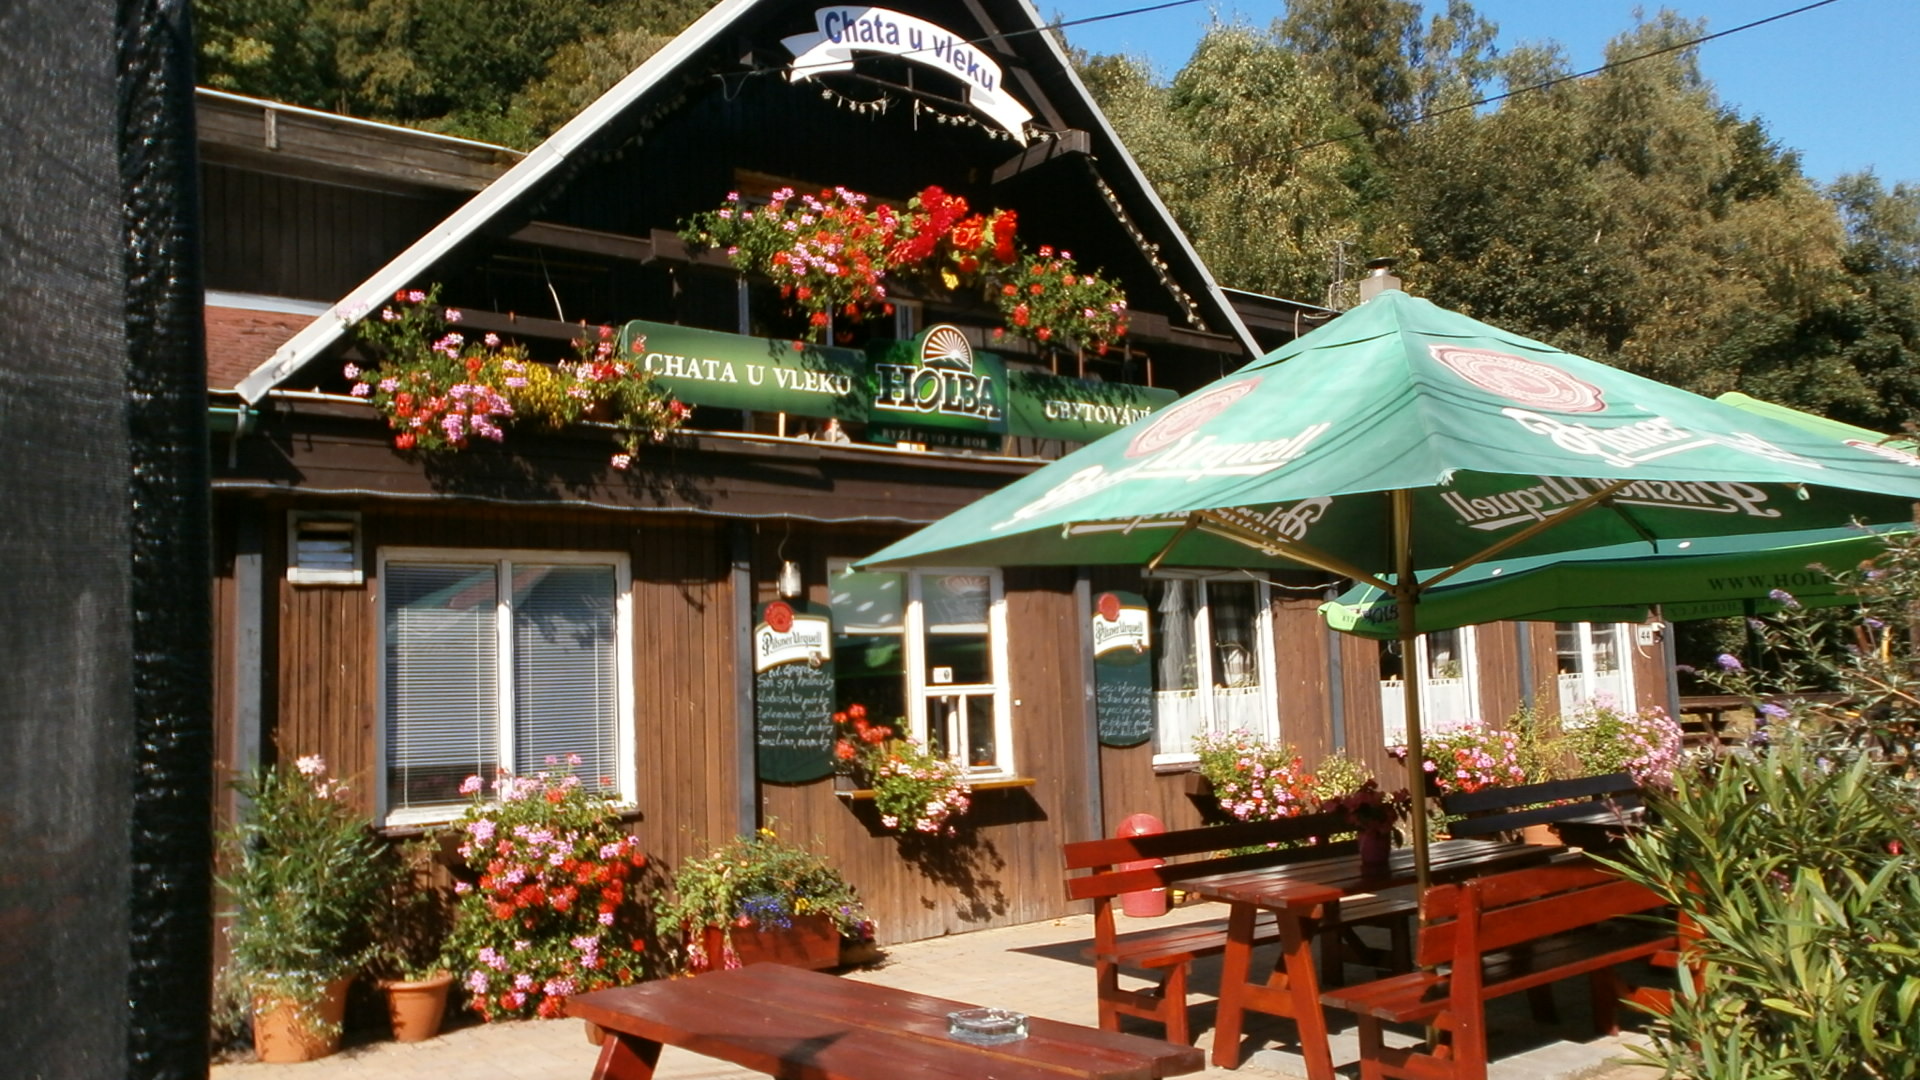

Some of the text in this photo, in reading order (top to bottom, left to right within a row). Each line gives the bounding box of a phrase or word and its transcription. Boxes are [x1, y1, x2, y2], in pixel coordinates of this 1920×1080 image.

[825, 11, 994, 92] Chata u vleku
[645, 353, 852, 396] CHATA U VLEKU
[875, 363, 1002, 421] HOLBA
[762, 631, 822, 656] Pilsner Urquell
[1640, 631, 1650, 639] 44
